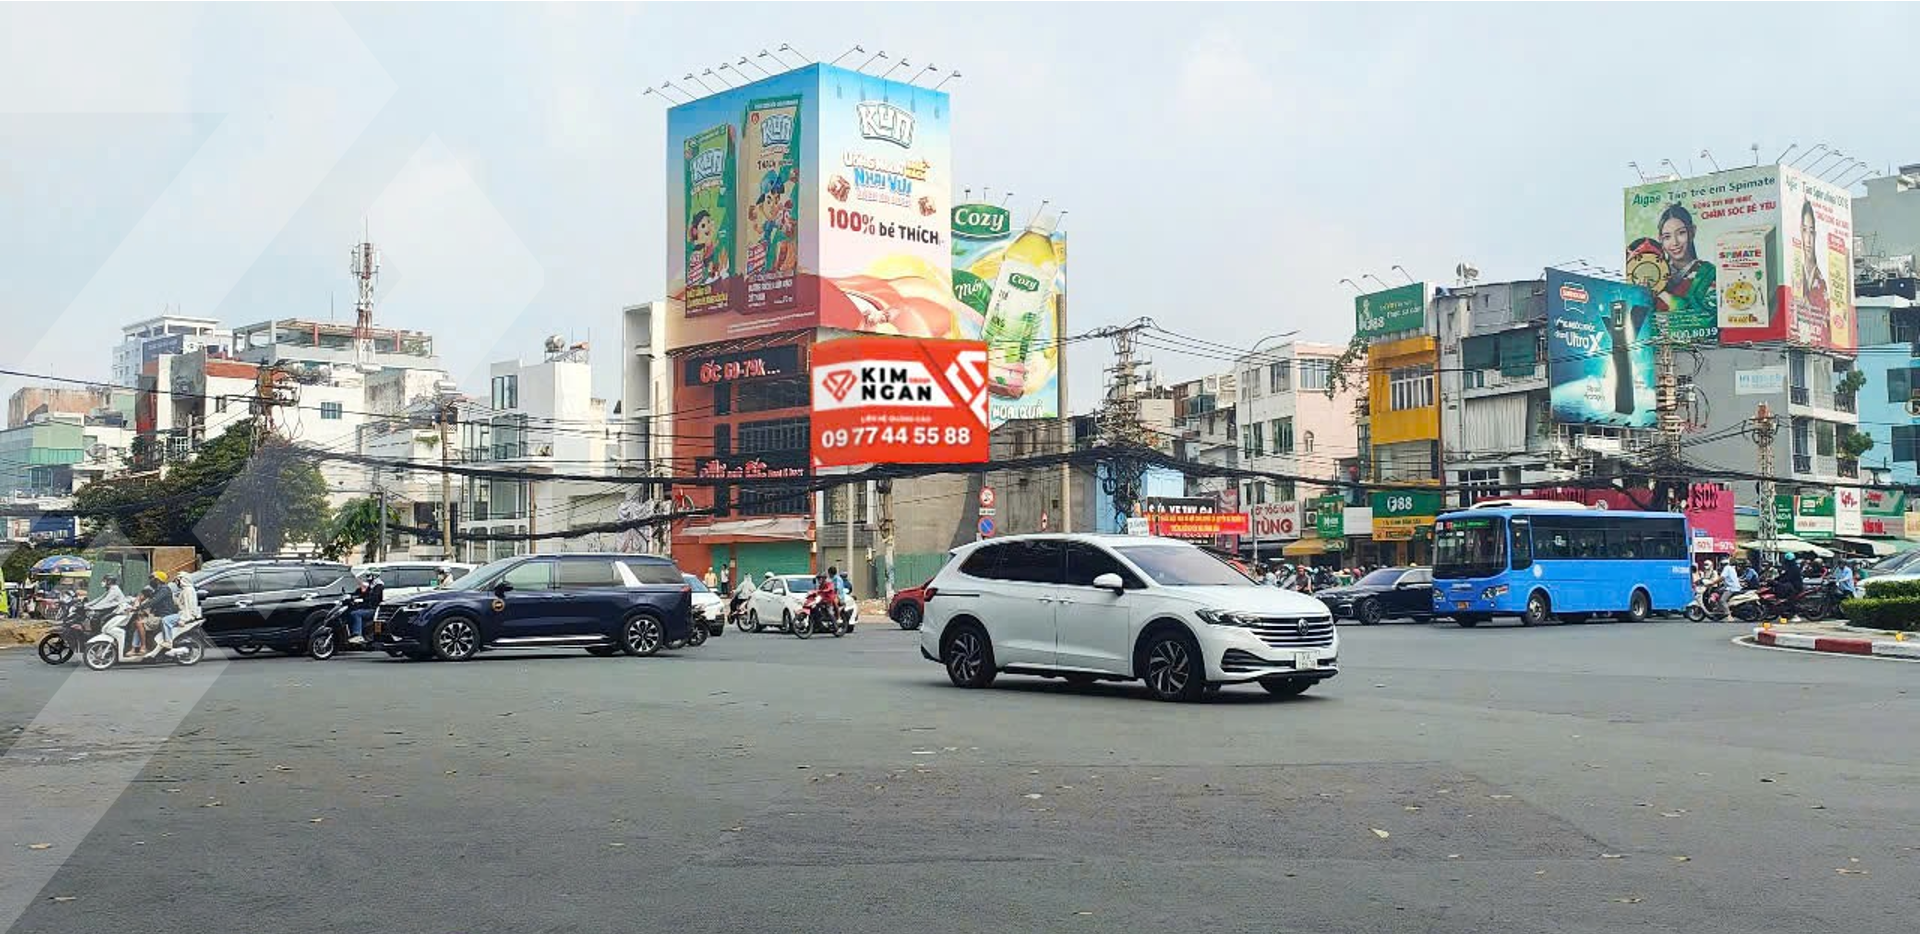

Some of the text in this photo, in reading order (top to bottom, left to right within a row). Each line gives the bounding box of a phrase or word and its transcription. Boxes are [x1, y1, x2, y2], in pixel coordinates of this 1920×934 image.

[828, 206, 939, 245] 100% bé THÍCH
[954, 208, 1005, 232] Cozy
[1011, 273, 1038, 291] Cozy
[861, 367, 908, 384] KIM
[861, 385, 932, 401] NGAN
[821, 425, 971, 449] 09 77 44 55 88
